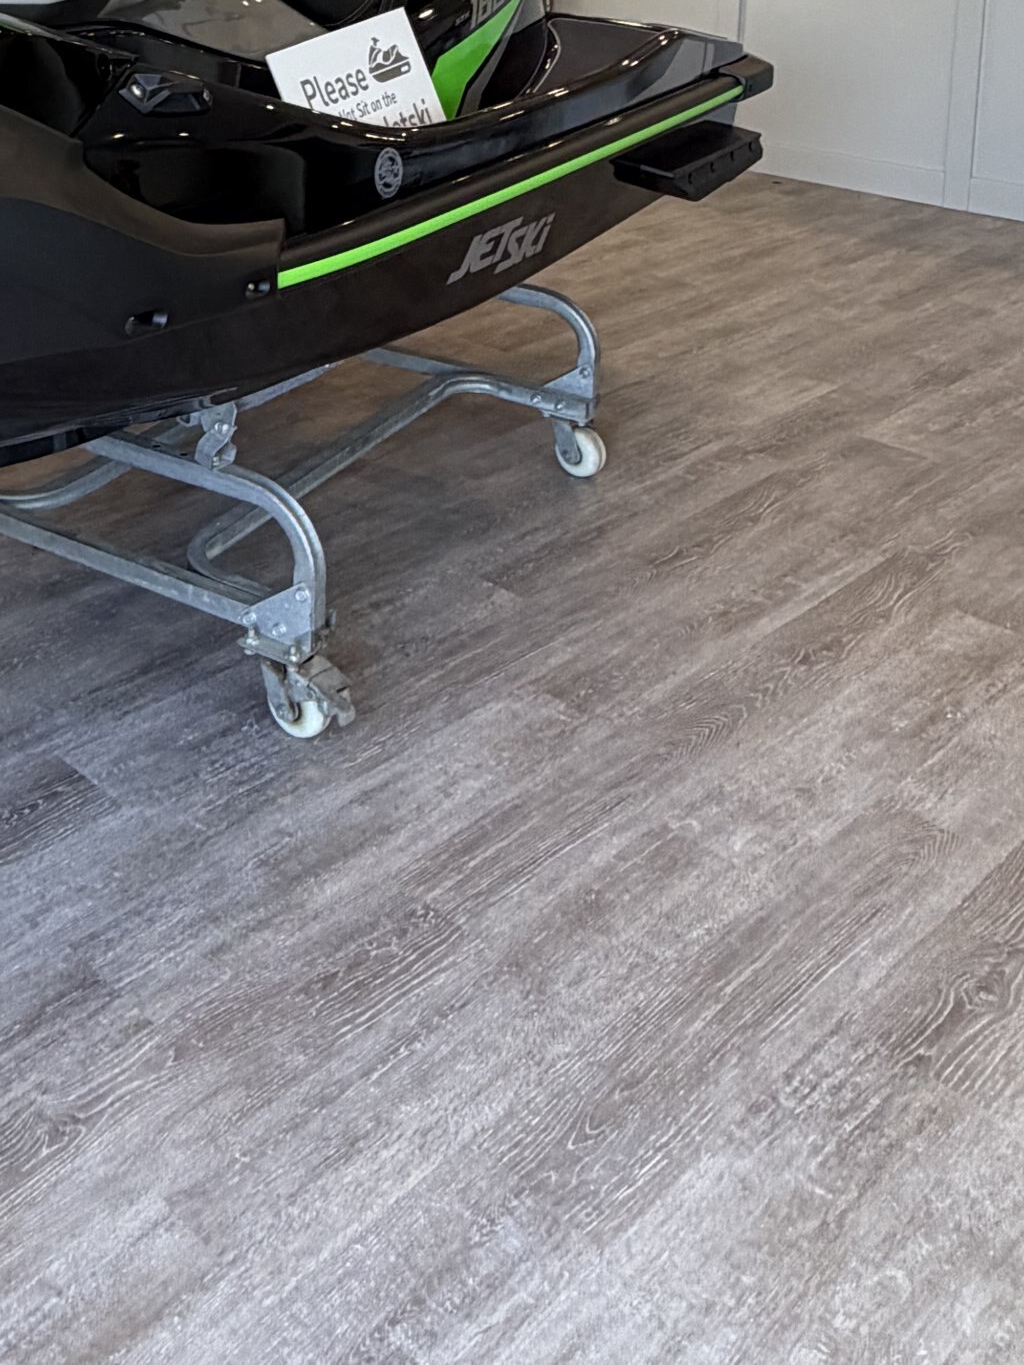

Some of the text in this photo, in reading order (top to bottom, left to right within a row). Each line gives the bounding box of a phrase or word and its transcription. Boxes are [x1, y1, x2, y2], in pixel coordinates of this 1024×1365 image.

[299, 68, 370, 110] Please
[355, 99, 372, 118] Sit
[370, 99, 383, 113] on
[382, 91, 398, 107] the
